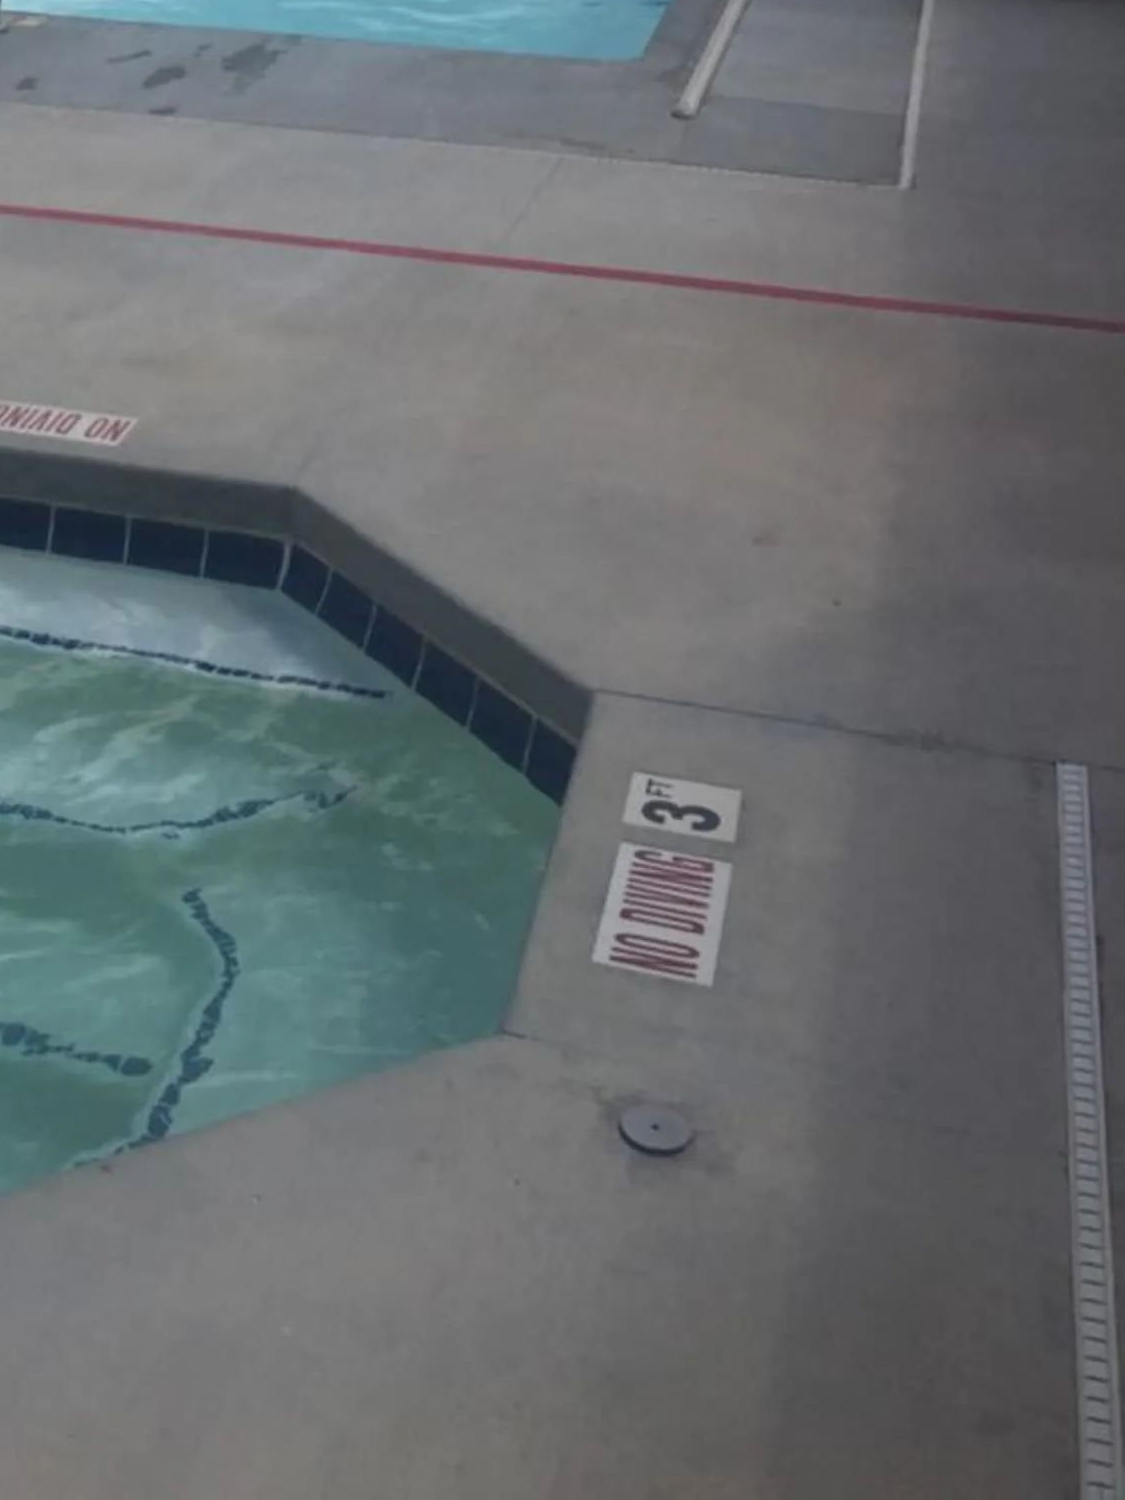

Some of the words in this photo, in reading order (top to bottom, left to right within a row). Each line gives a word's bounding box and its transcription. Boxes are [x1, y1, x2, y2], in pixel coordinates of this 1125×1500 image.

[84, 417, 131, 442] NO
[646, 778, 674, 799] FT
[641, 799, 721, 832] 3
[619, 850, 715, 935] DIVING
[608, 933, 700, 979] NO
